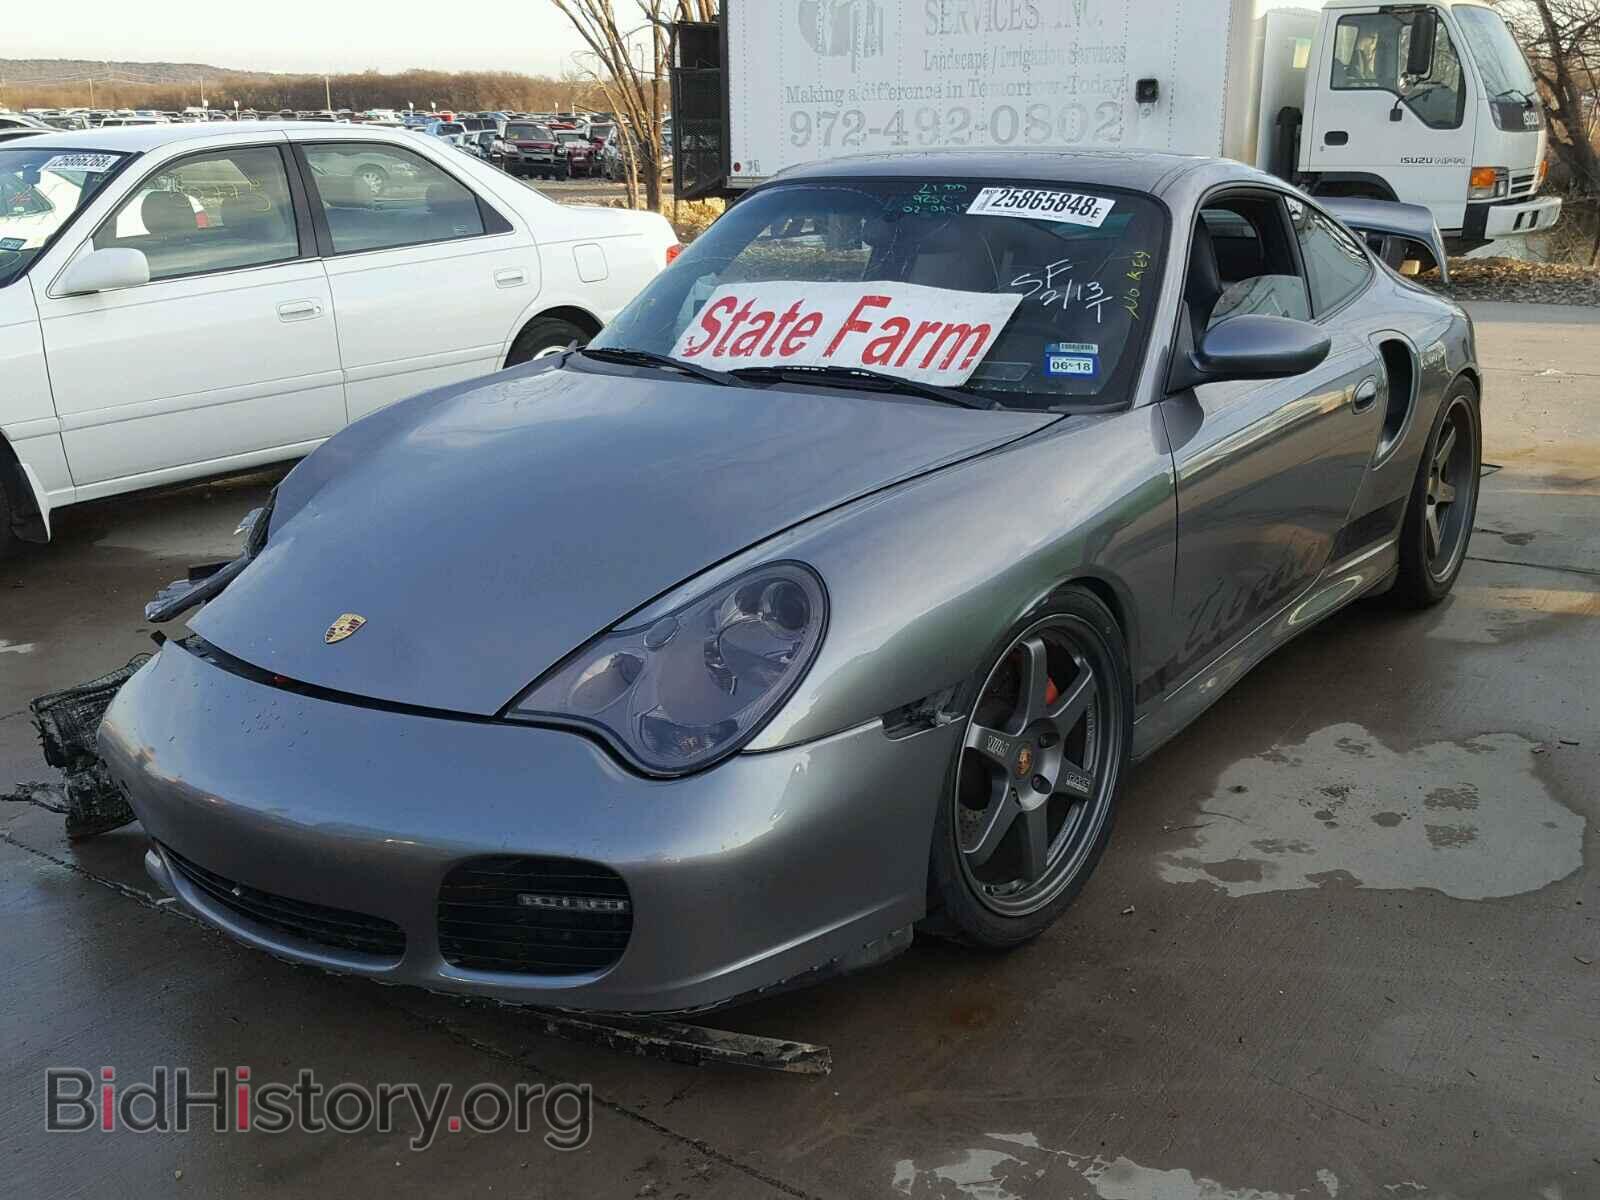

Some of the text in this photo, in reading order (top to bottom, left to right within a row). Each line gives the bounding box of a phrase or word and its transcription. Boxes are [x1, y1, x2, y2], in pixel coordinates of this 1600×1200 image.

[784, 85, 845, 107] Making
[946, 80, 964, 98] in
[789, 103, 1121, 147] 972-492-0802
[992, 189, 1097, 217] 25865848
[1011, 259, 1073, 298] SF
[682, 294, 992, 371] State Farm
